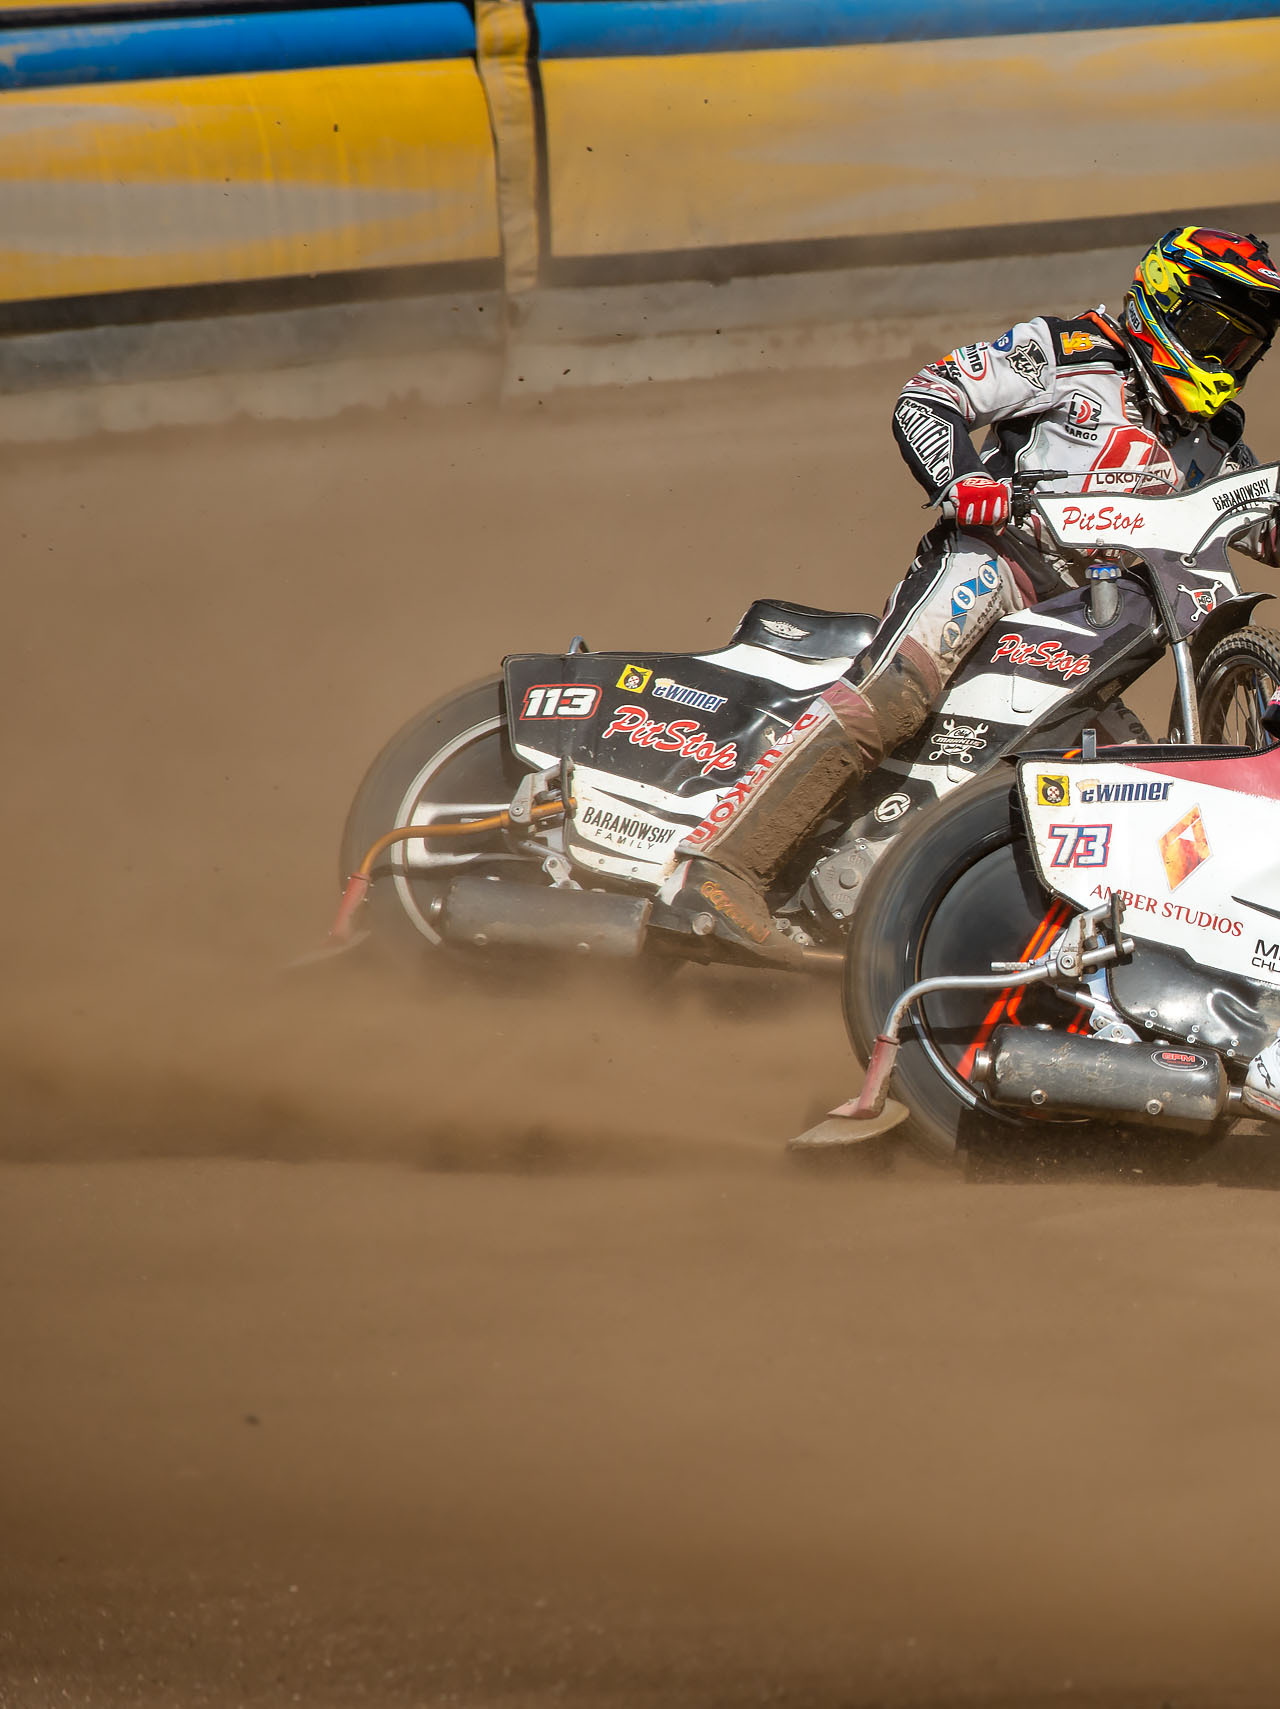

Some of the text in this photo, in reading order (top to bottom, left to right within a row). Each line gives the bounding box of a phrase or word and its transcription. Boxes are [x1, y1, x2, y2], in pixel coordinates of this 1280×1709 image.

[521, 684, 601, 719] 113
[582, 807, 676, 844] BARANOWSKY
[595, 829, 655, 850] FAMILY
[1048, 824, 1112, 868] 73
[1162, 902, 1244, 937] STUDIOS
